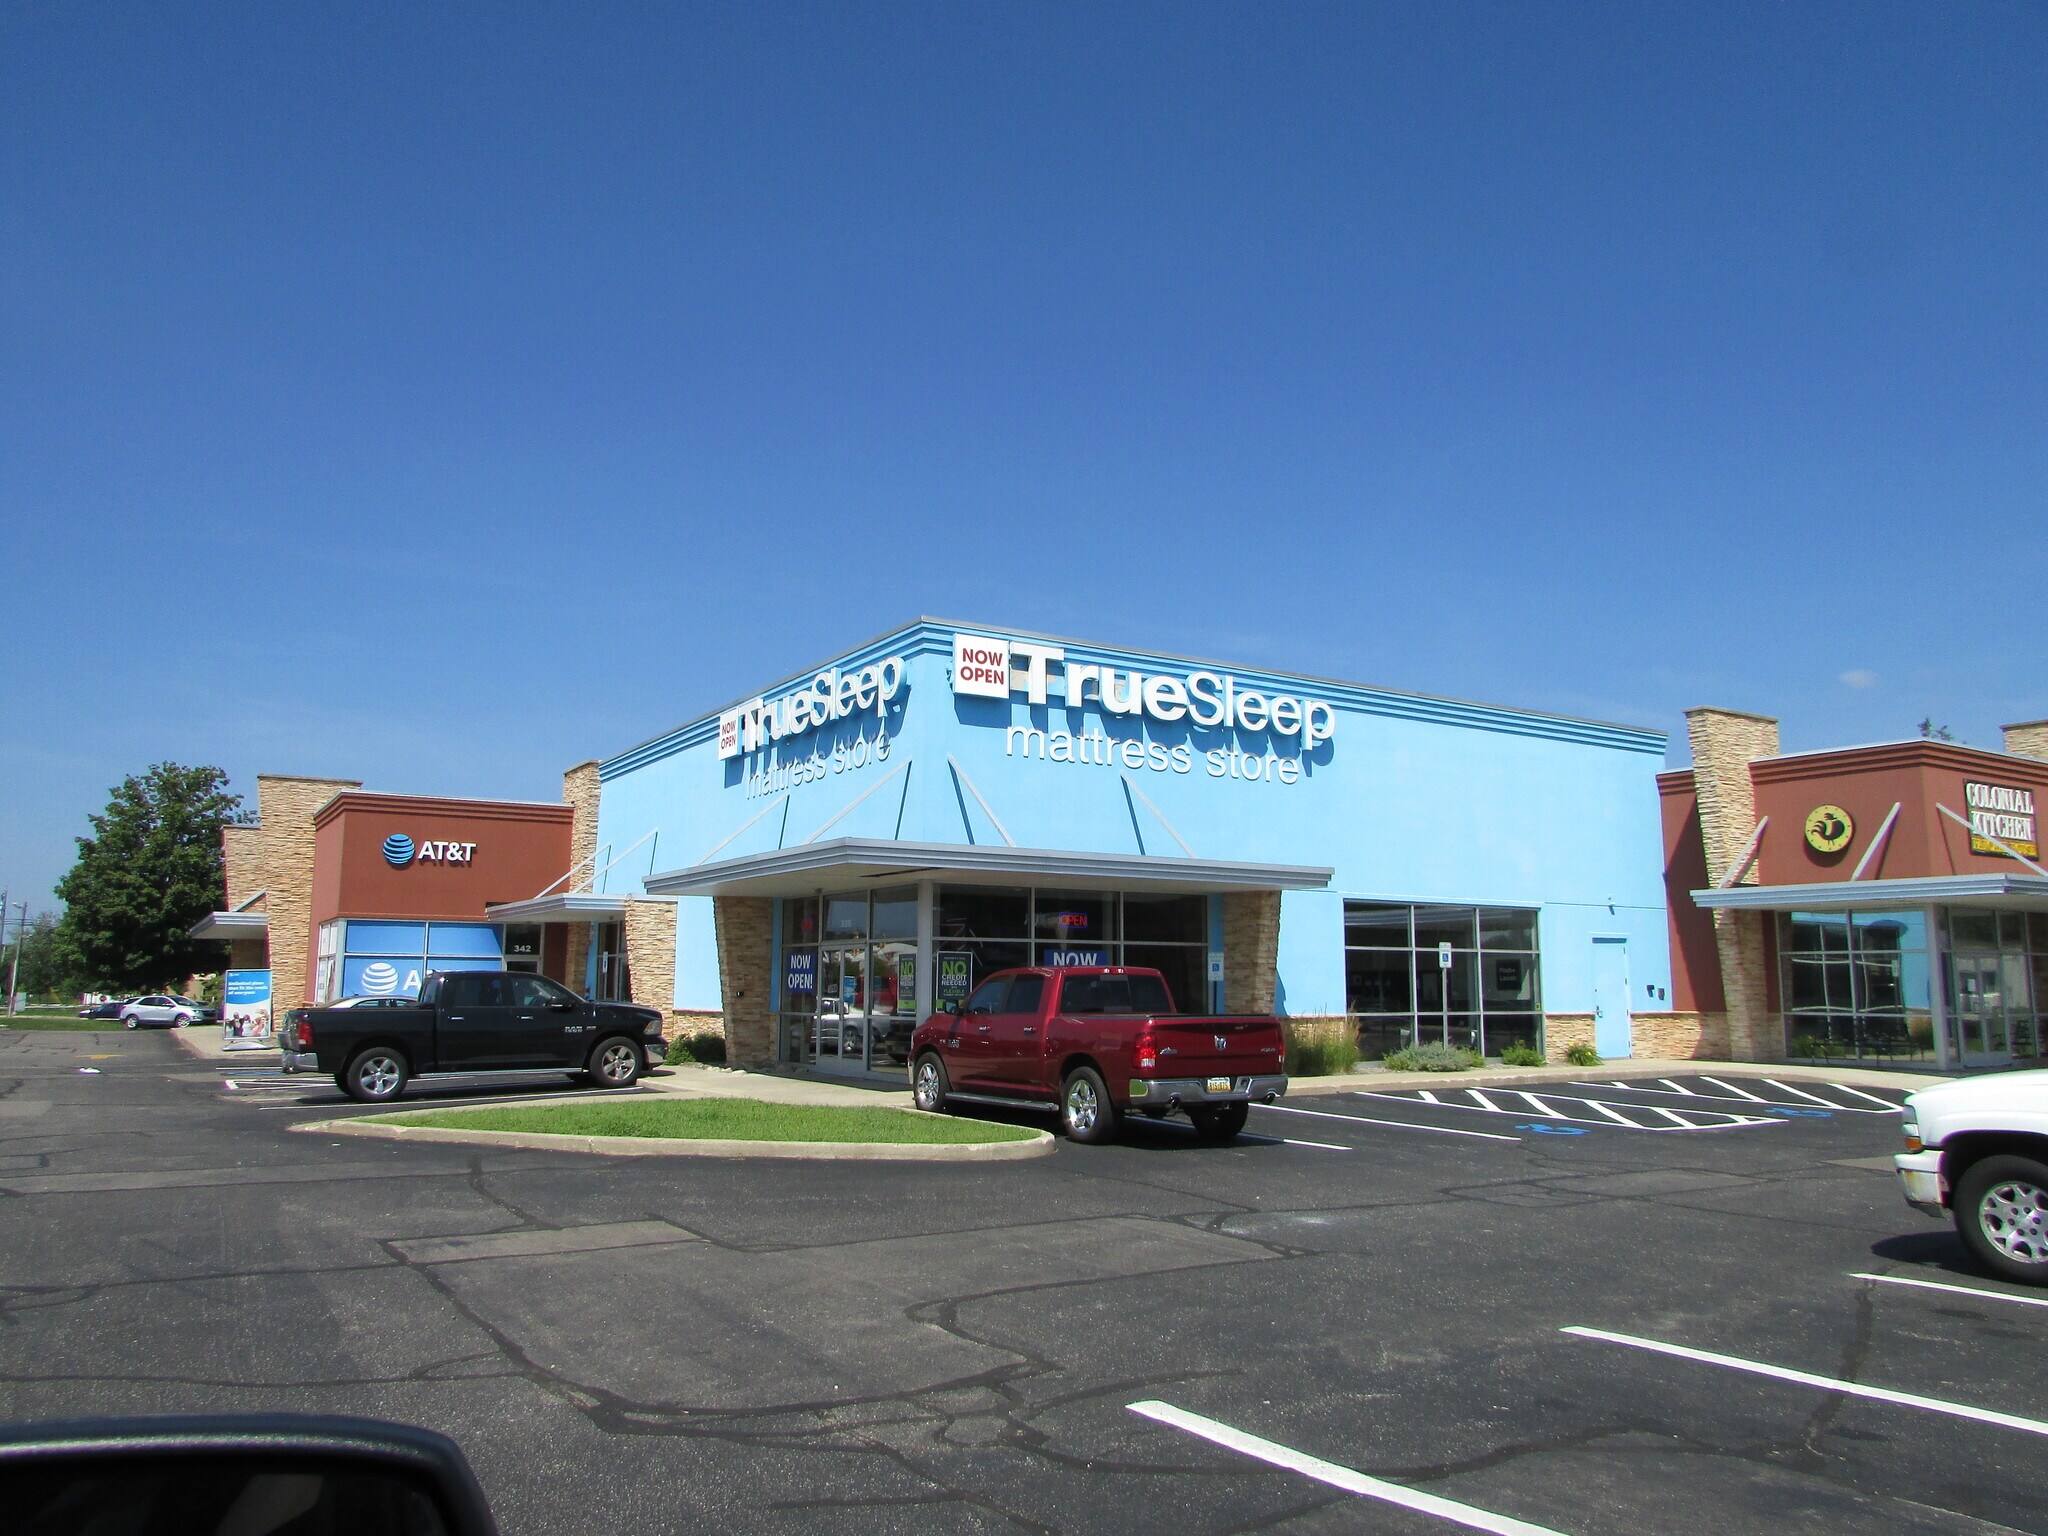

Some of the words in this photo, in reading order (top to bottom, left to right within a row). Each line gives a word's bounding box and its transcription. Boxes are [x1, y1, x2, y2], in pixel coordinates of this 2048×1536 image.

[962, 648, 1003, 667] NOW
[960, 666, 1004, 685] OPEN
[738, 656, 904, 752] TrueSleep
[1010, 641, 1336, 750] TrueSleep
[722, 720, 736, 736] NOW
[721, 734, 736, 750] OPEN
[1006, 725, 1192, 774] mattress
[1206, 742, 1299, 784] store
[747, 750, 827, 800] mattress
[834, 731, 891, 775] store
[1966, 783, 2034, 814] COLONIAL
[1970, 811, 2032, 840] KITCHEN
[418, 841, 477, 861] AT&T
[1060, 914, 1087, 926] OPEN
[514, 944, 531, 953] 342
[790, 954, 811, 969] NOW
[1053, 952, 1098, 966] NOW
[900, 961, 914, 976] NO
[942, 960, 967, 976] NO
[788, 973, 813, 989] OPEN!
